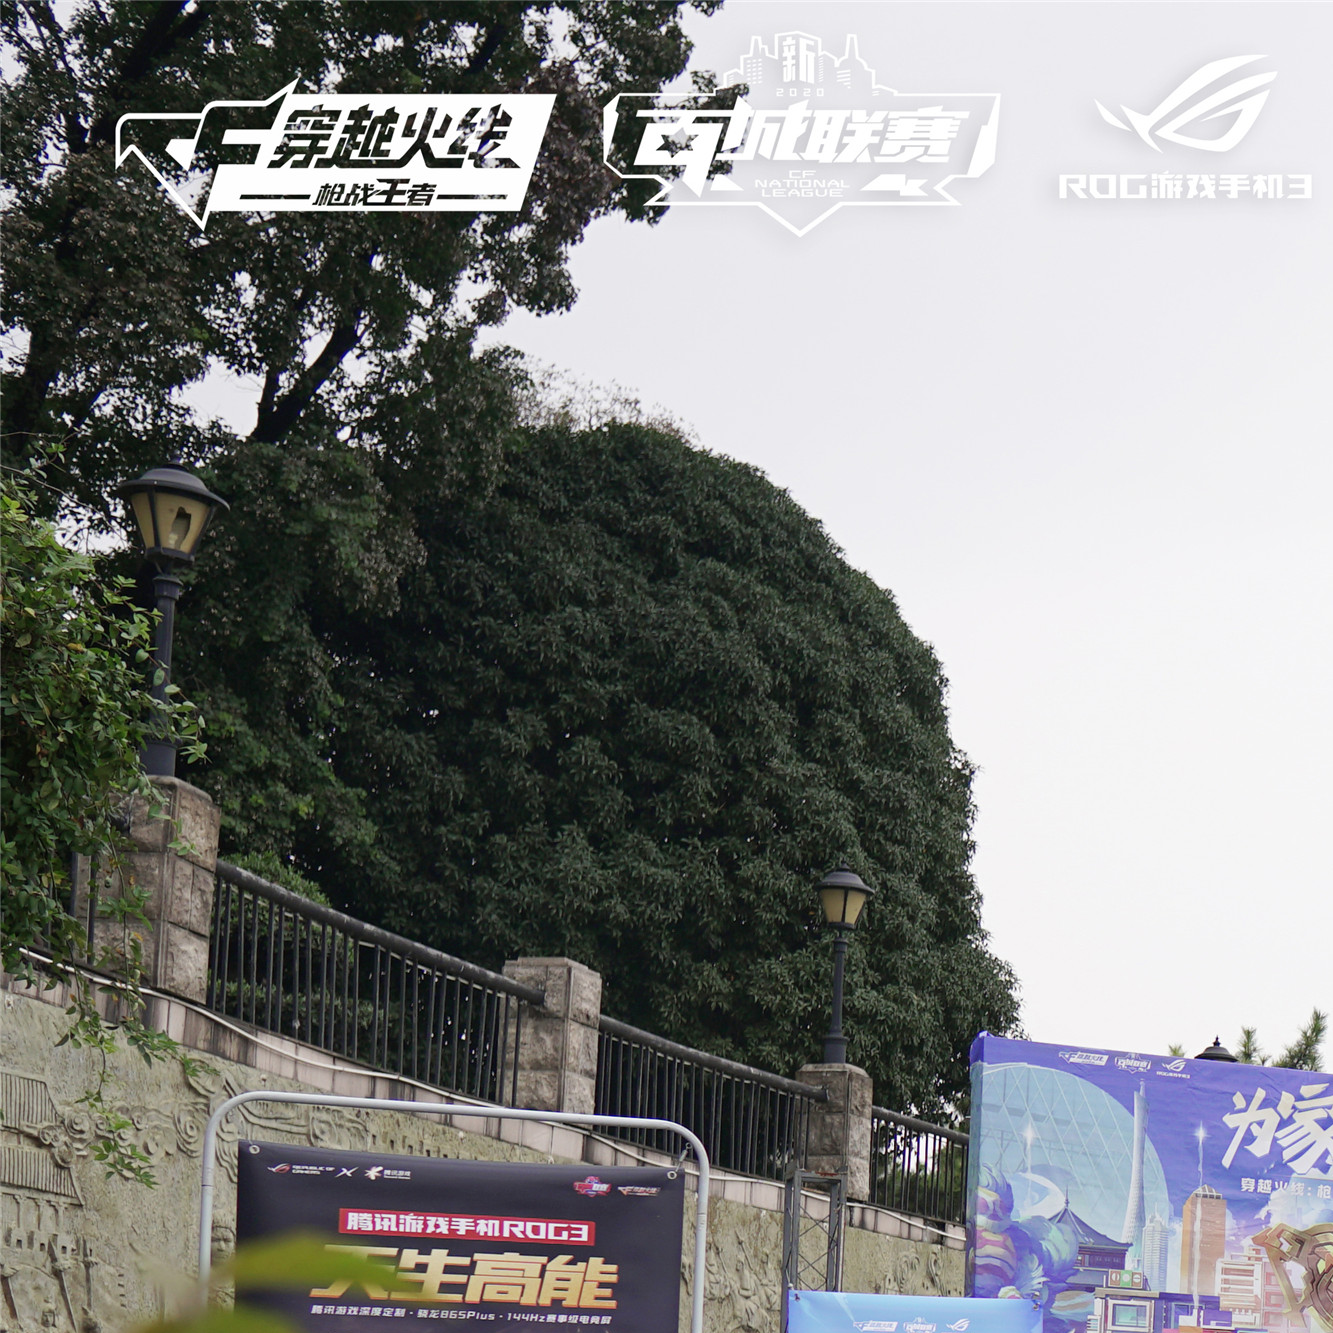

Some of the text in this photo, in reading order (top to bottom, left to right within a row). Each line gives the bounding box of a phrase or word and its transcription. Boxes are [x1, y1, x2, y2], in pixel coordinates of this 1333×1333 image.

[346, 1211, 589, 1243] 腾讯游戏手机ROG3
